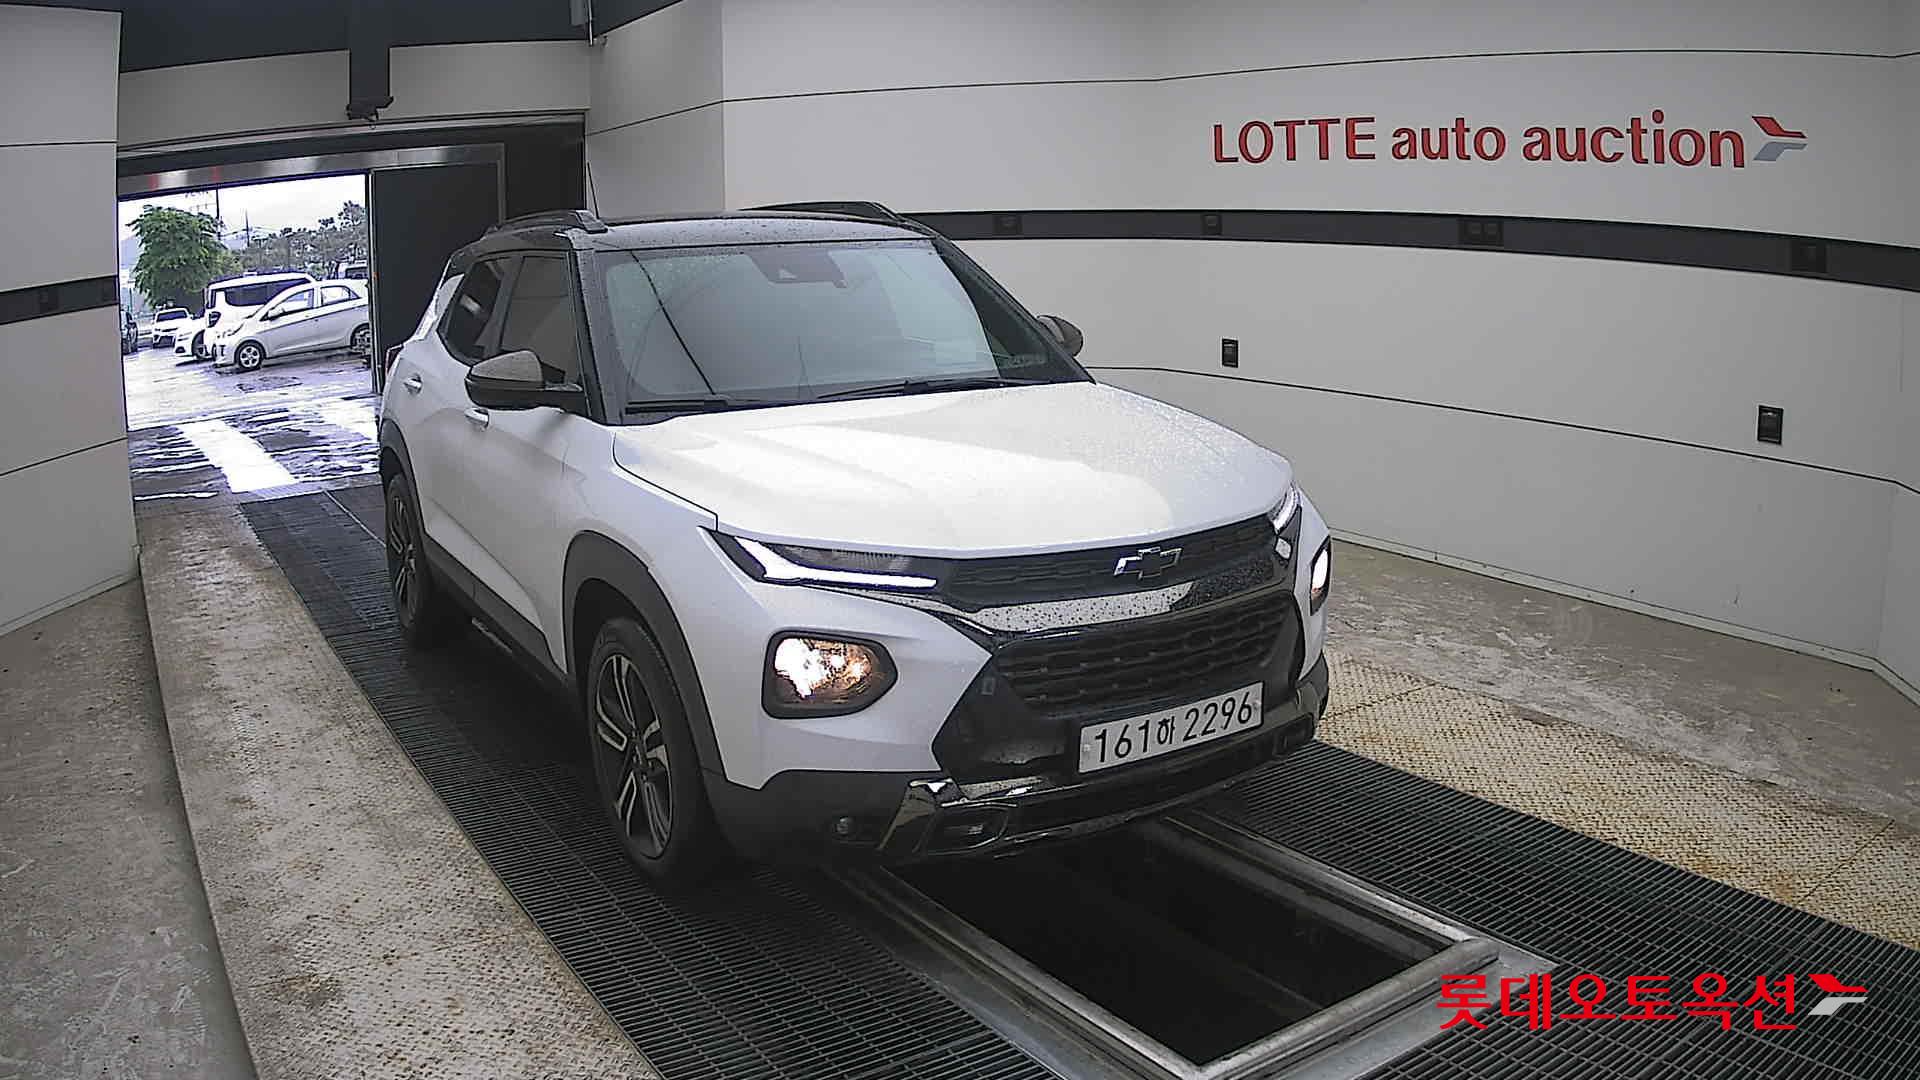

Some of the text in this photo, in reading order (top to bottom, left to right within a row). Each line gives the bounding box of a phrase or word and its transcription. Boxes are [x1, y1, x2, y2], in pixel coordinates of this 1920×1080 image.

[1213, 109, 1745, 168] LOTTE auto auction
[1094, 691, 1253, 763] 161하 2296
